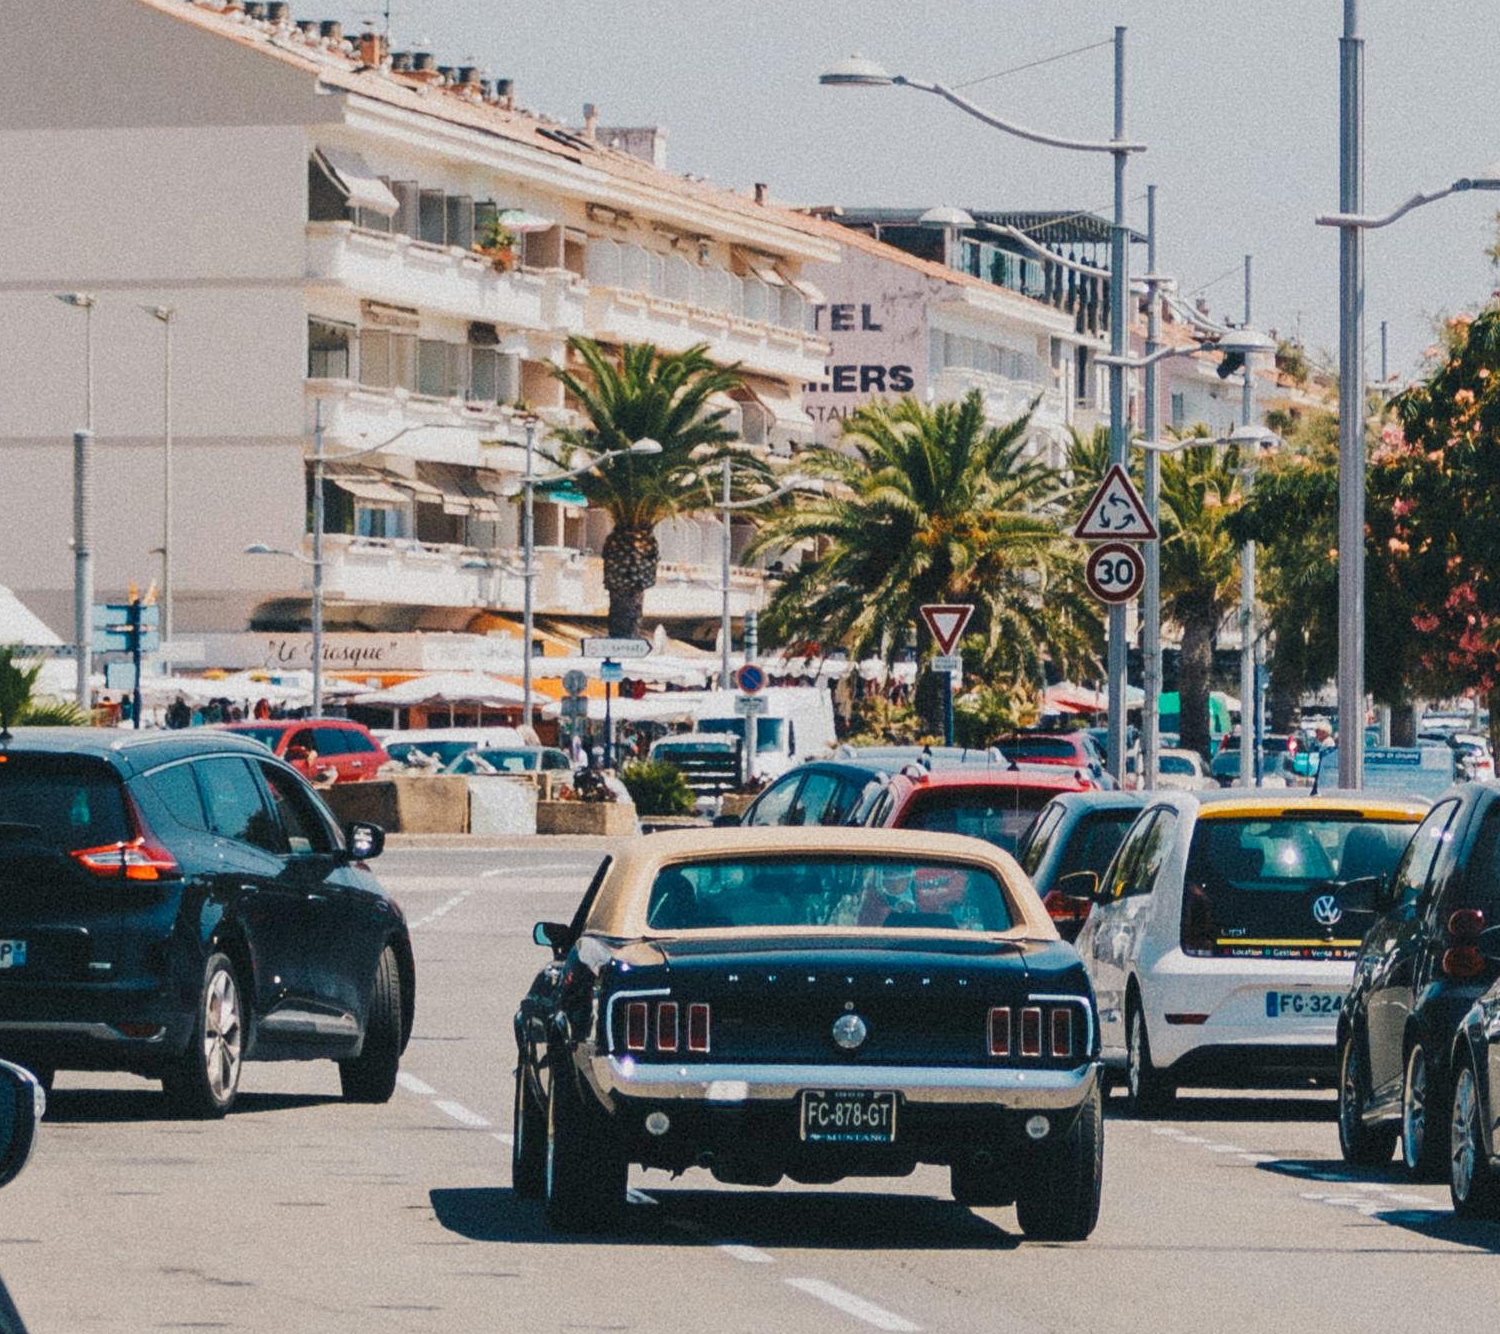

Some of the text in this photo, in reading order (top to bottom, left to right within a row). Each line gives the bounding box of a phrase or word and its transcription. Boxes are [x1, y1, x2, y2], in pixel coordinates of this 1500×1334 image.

[1097, 558, 1134, 586] 30
[808, 1101, 890, 1127] FC-878-GT
[826, 1133, 887, 1142] MUSTANG
